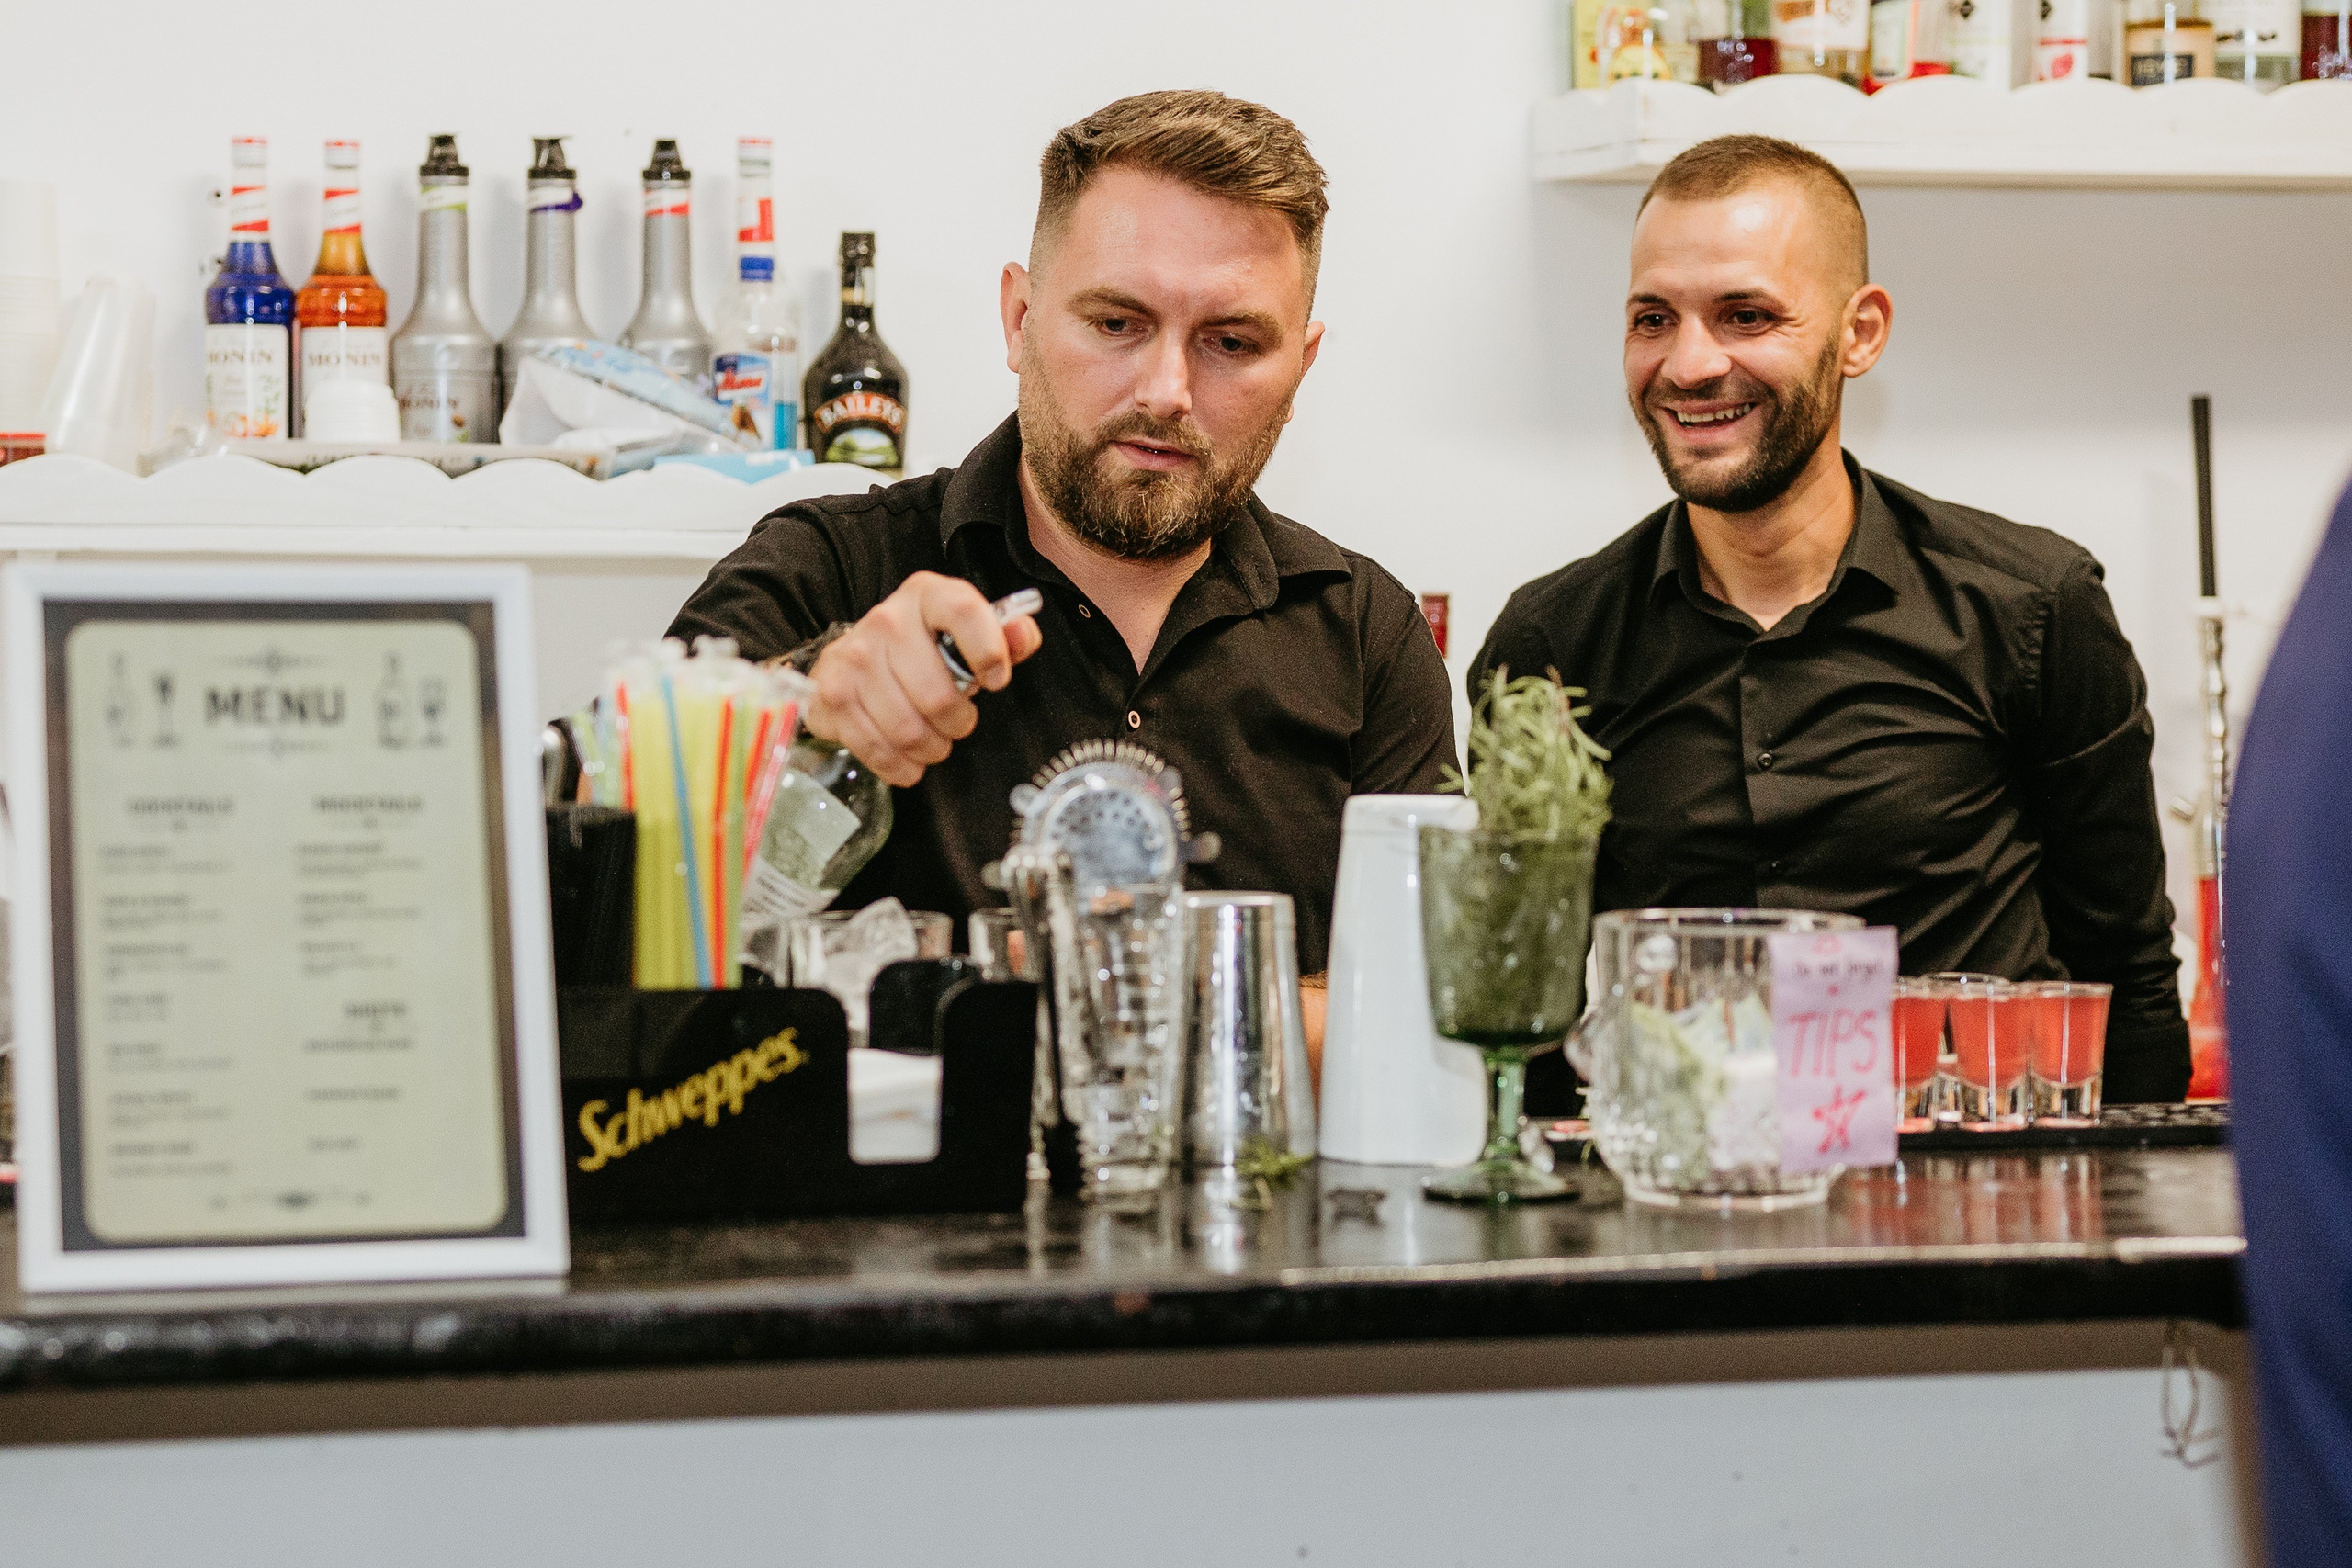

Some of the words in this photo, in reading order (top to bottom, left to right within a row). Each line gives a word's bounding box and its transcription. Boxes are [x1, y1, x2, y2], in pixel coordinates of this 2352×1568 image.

[820, 393, 903, 429] BAILEYS
[205, 685, 345, 728] MENU
[1783, 1008, 1879, 1078] TIPS
[577, 1026, 803, 1173] Schweppes
